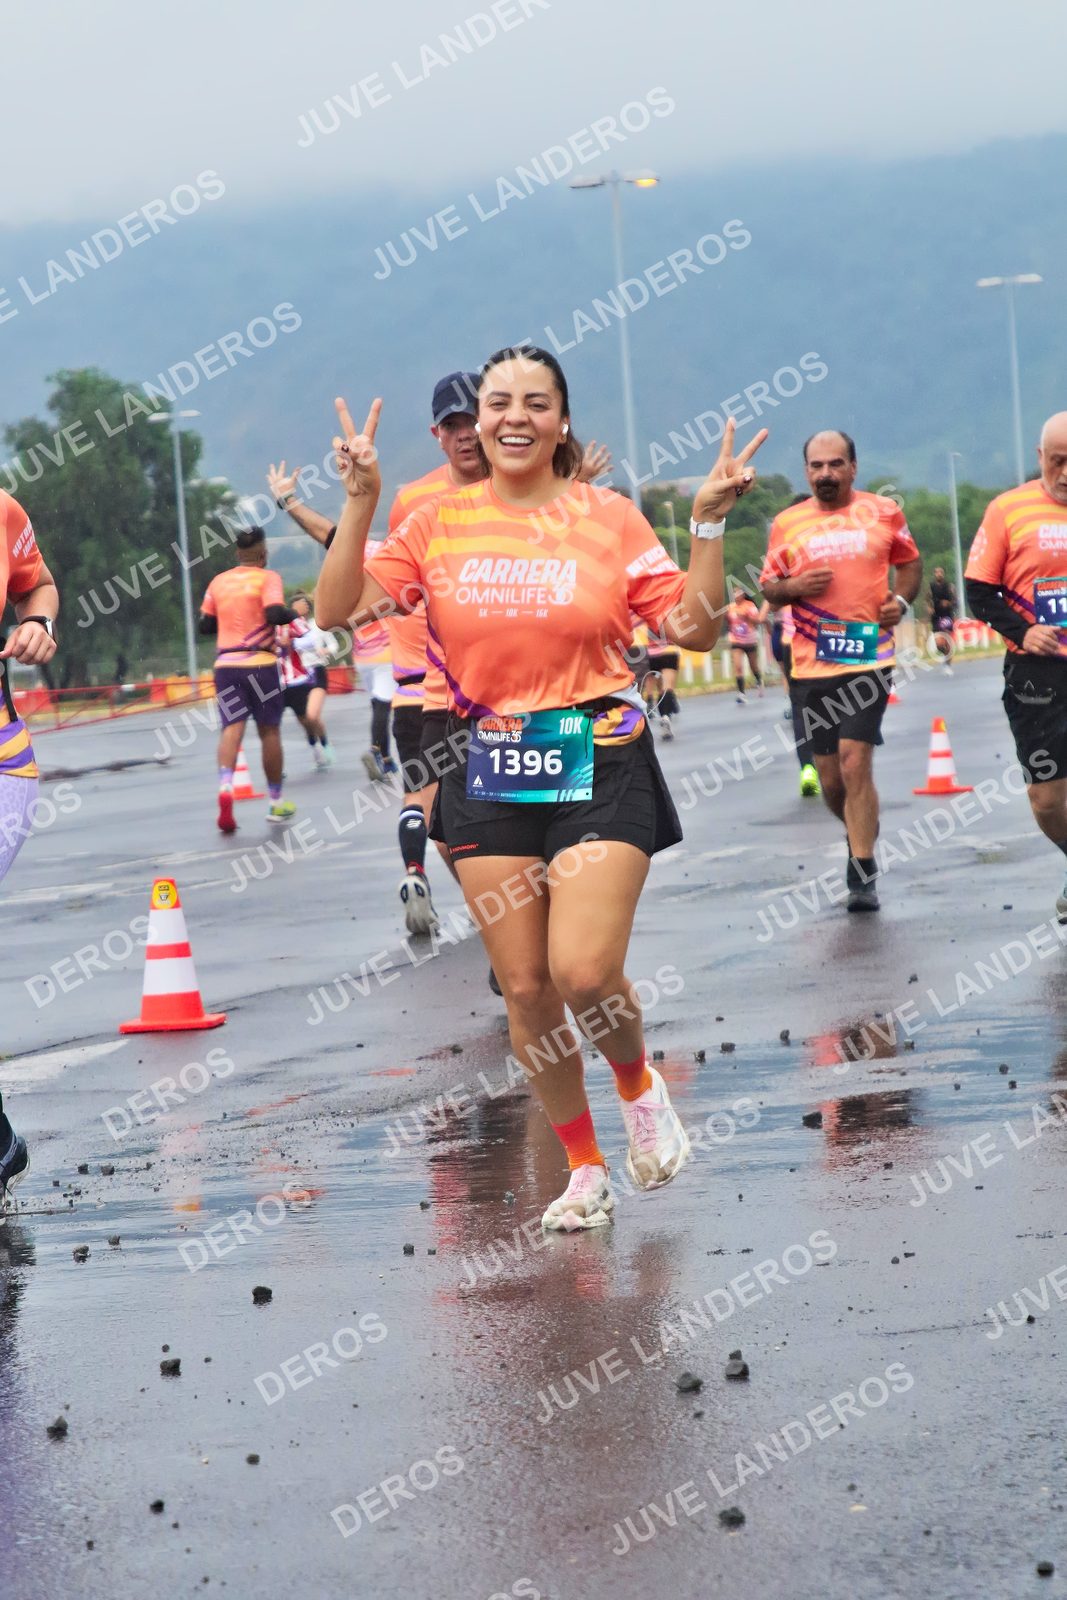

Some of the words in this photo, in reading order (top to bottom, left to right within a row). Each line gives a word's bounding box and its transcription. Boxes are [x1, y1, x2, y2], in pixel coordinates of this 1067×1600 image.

[458, 558, 576, 585] CARRERA
[828, 638, 865, 653] 1723
[559, 716, 584, 735] 10K
[489, 748, 563, 775] 1396
